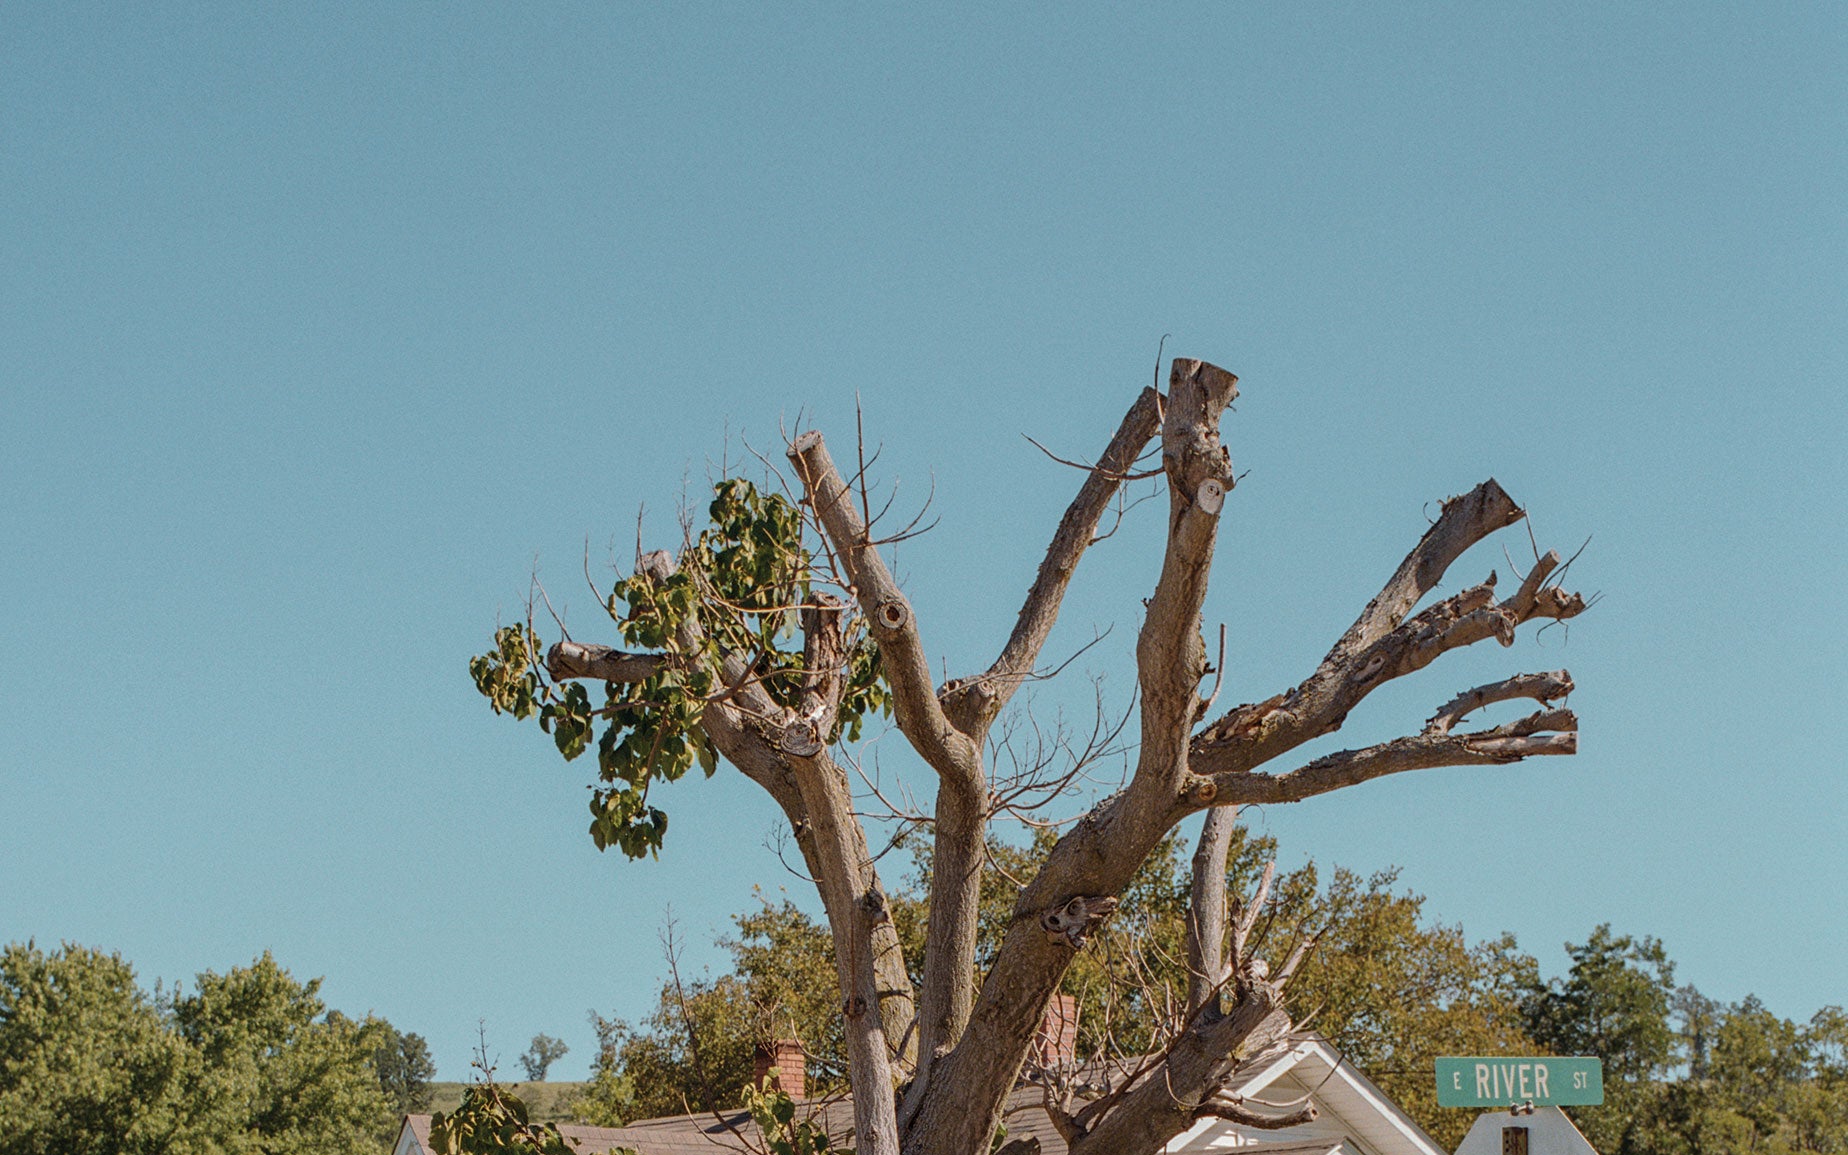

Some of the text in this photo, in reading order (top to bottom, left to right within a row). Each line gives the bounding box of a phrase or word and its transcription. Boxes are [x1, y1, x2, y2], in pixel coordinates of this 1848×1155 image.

[1453, 1063, 1588, 1099] E RIVER ST
